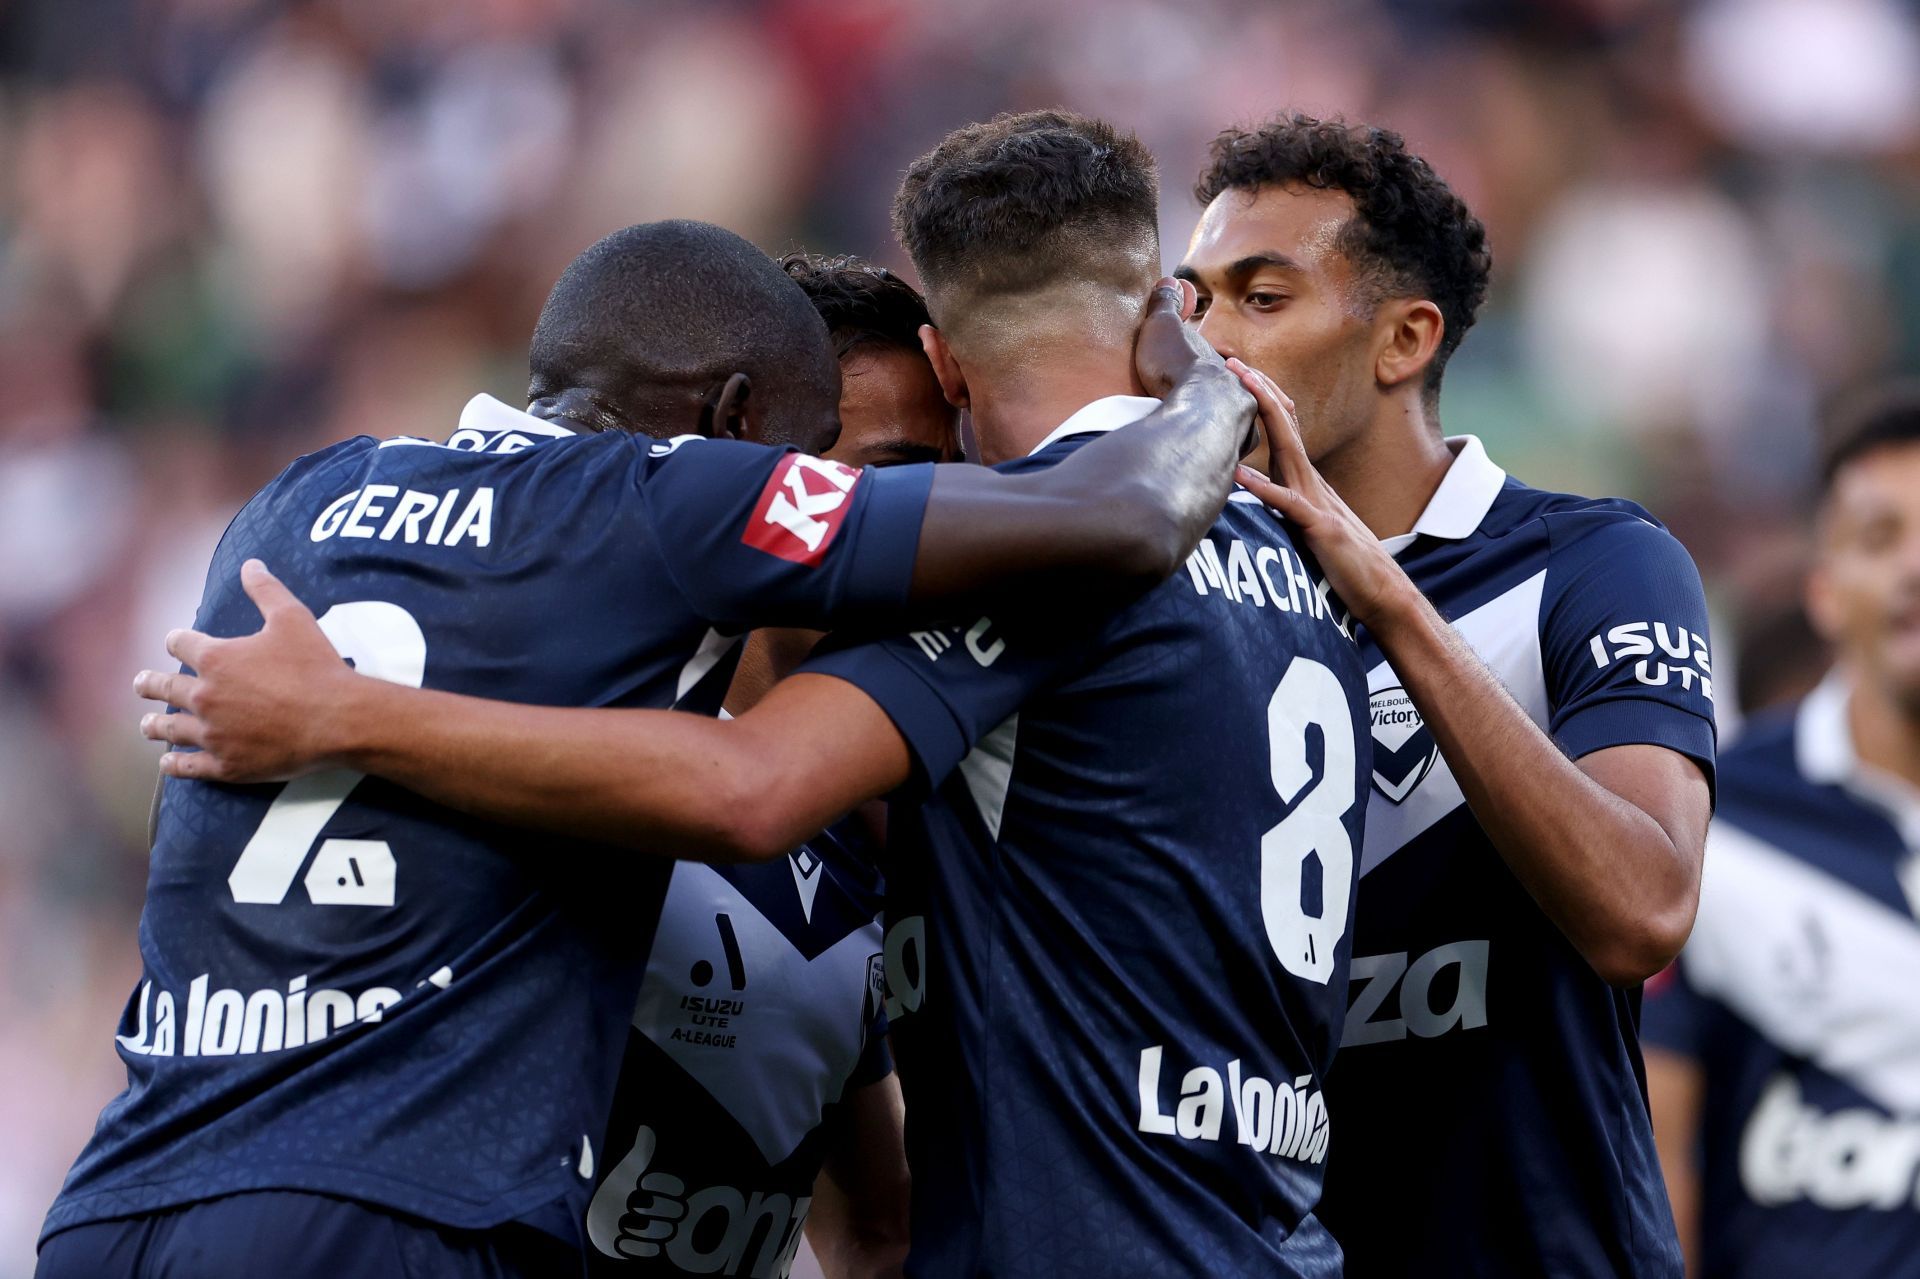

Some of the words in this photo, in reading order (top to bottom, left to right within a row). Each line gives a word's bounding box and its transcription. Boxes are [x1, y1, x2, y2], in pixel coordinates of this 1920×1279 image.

[310, 484, 494, 547] GERIA
[764, 453, 864, 552] KF
[1185, 538, 1354, 642] MACH
[1589, 621, 1712, 669] ISUZ
[1370, 698, 1411, 708] MELBOUR
[1260, 655, 1356, 985] 8
[115, 980, 176, 1057] La
[680, 995, 744, 1015] ISUZU
[692, 1014, 729, 1033] UTE
[670, 1027, 737, 1049] A-LEAGUE
[1138, 1045, 1224, 1140] La
